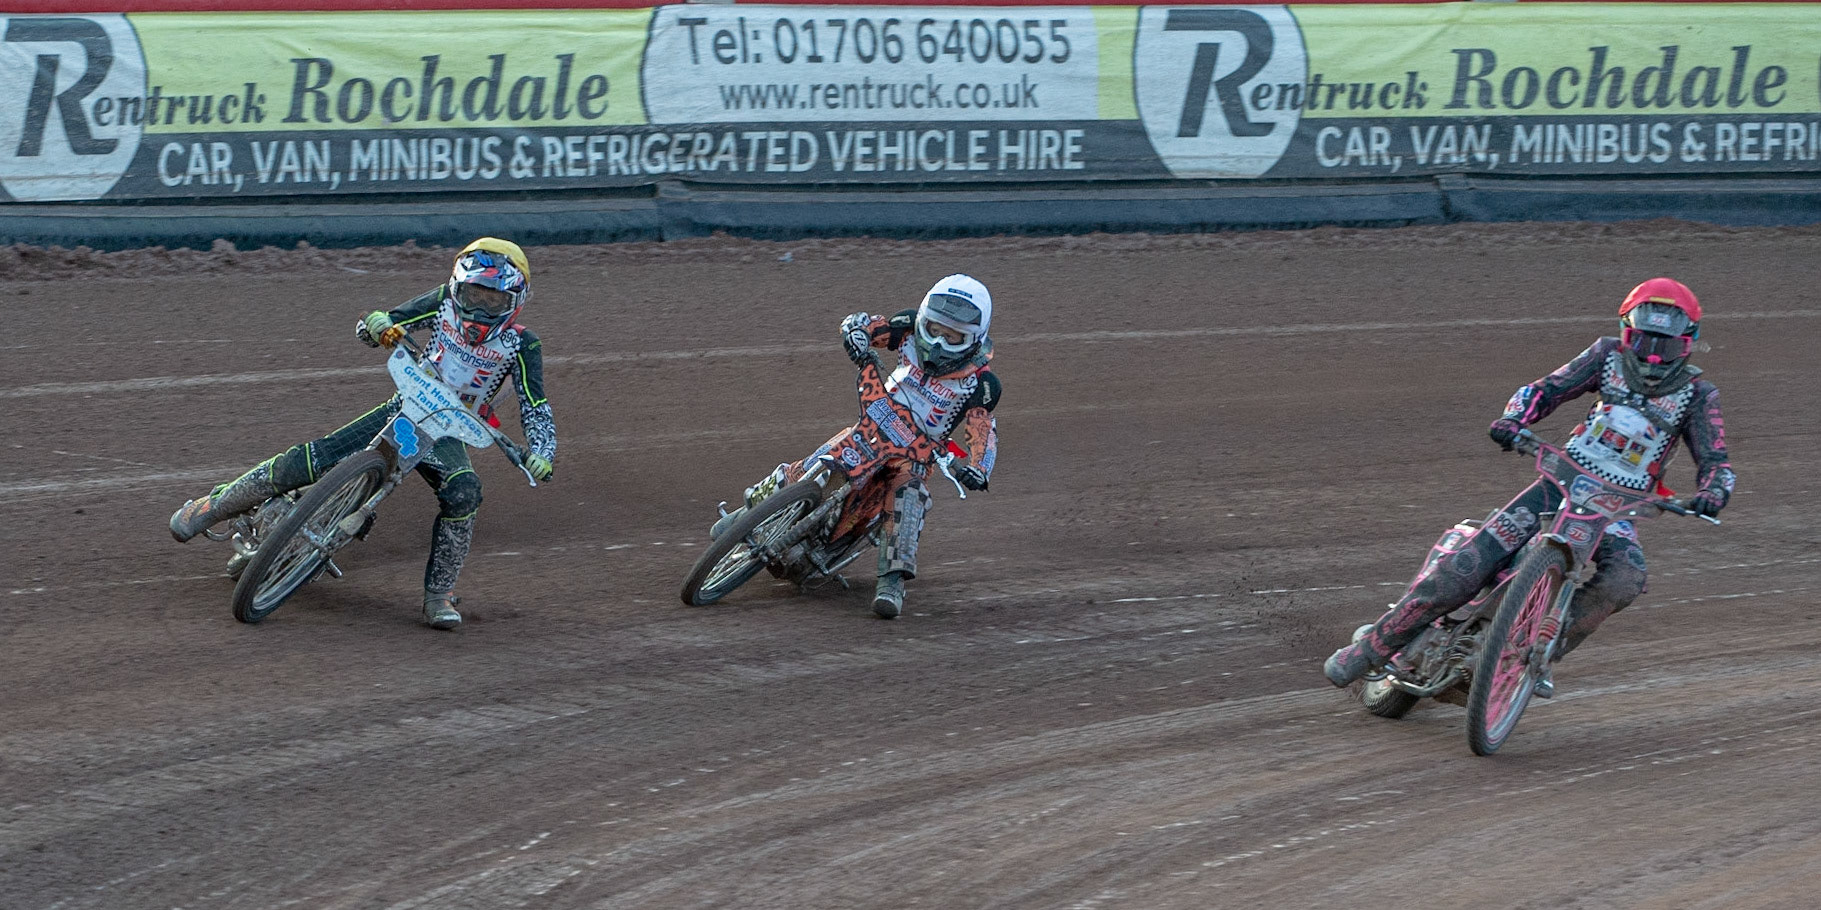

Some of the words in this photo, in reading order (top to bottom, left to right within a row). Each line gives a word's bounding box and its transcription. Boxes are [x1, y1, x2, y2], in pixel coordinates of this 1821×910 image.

[678, 17, 762, 65] Tel:
[773, 17, 903, 65] 01706
[917, 17, 1072, 65] 640055
[4, 17, 268, 157] Rentruck
[282, 53, 611, 124] Rochdale
[719, 73, 1040, 110] www.rentruck.co.uk
[1163, 9, 1430, 138] Rentruck
[1443, 45, 1789, 110] Rochdale
[157, 141, 245, 192] CAR,
[250, 140, 343, 190] VAN,
[348, 136, 503, 183] MINIBUS
[509, 136, 537, 179] &
[542, 130, 820, 179] REFRIGERATED
[826, 129, 990, 173] VEHICLE
[998, 128, 1086, 171] HIRE
[1315, 126, 1402, 174] CAR,
[1411, 125, 1500, 170] VAN,
[1508, 123, 1673, 165] MINIBUS
[1680, 122, 1708, 163] &
[1714, 121, 1821, 161] REFRI
[440, 332, 497, 370] CHAMPIONSHIP
[500, 330, 518, 345] 696
[404, 366, 431, 390] Grant
[929, 377, 957, 400] YOUTH
